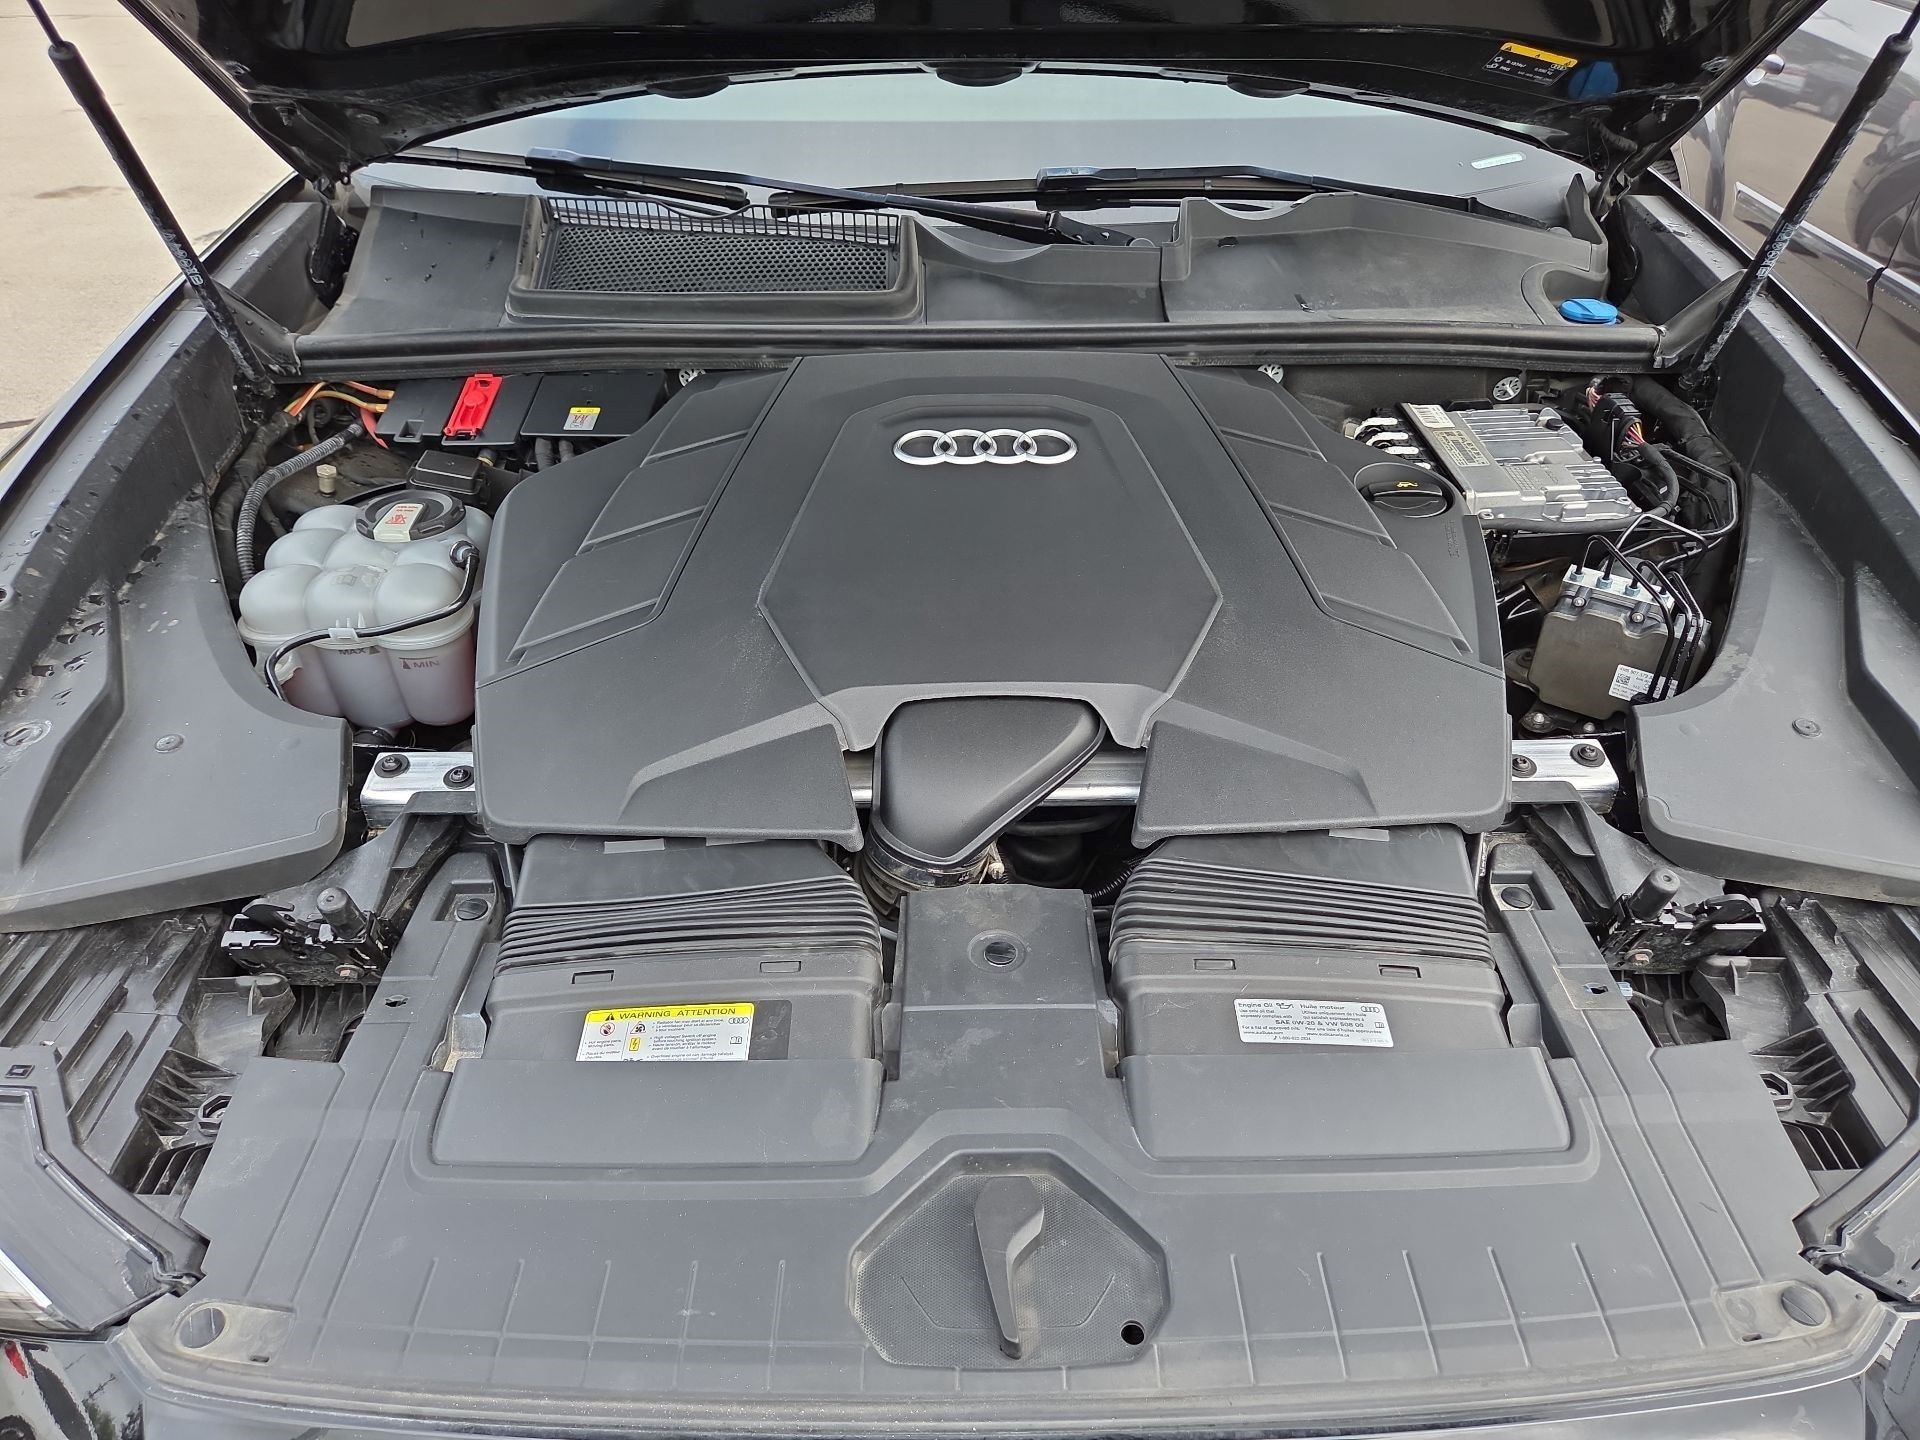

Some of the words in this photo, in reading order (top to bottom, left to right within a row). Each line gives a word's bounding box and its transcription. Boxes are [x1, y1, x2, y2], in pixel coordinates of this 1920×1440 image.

[338, 647, 367, 655] MAX
[412, 660, 440, 669] MIN
[619, 1010, 671, 1020] WARNING
[676, 1008, 736, 1017] ATTENTION
